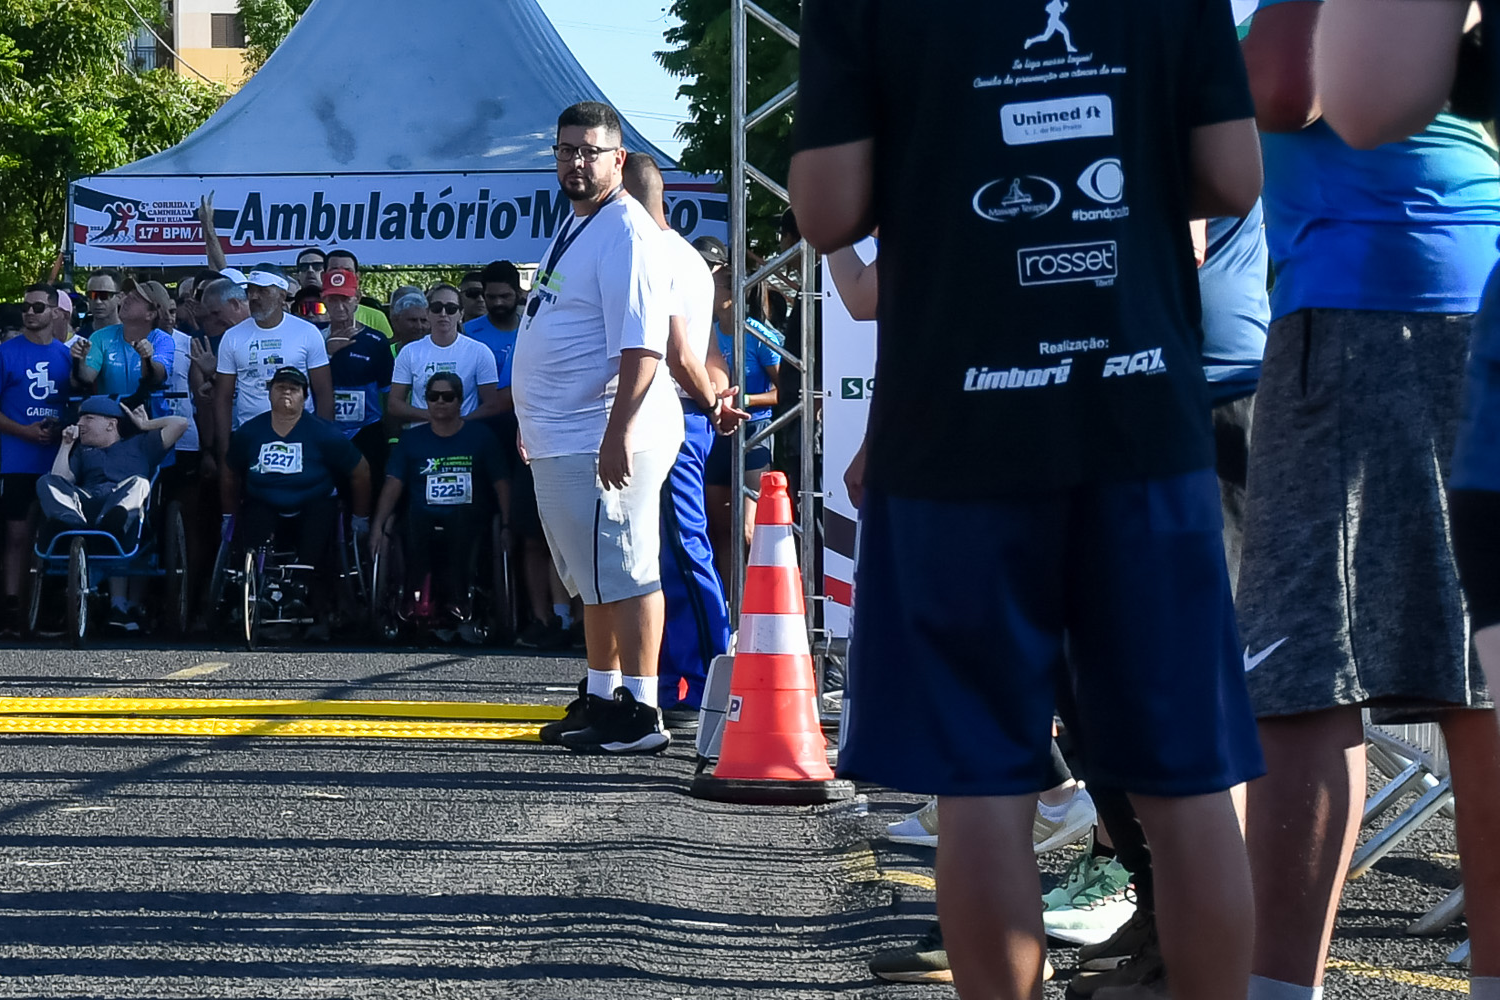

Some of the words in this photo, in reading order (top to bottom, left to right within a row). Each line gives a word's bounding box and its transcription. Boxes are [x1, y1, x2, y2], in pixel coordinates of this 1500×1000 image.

[1012, 107, 1081, 126] Unimed
[233, 186, 518, 241] Ambulatório
[1025, 249, 1112, 276] rosset
[1039, 338, 1110, 355] Realização:
[335, 403, 356, 415] 217
[263, 453, 294, 467] 5227
[431, 485, 464, 498] 5225
